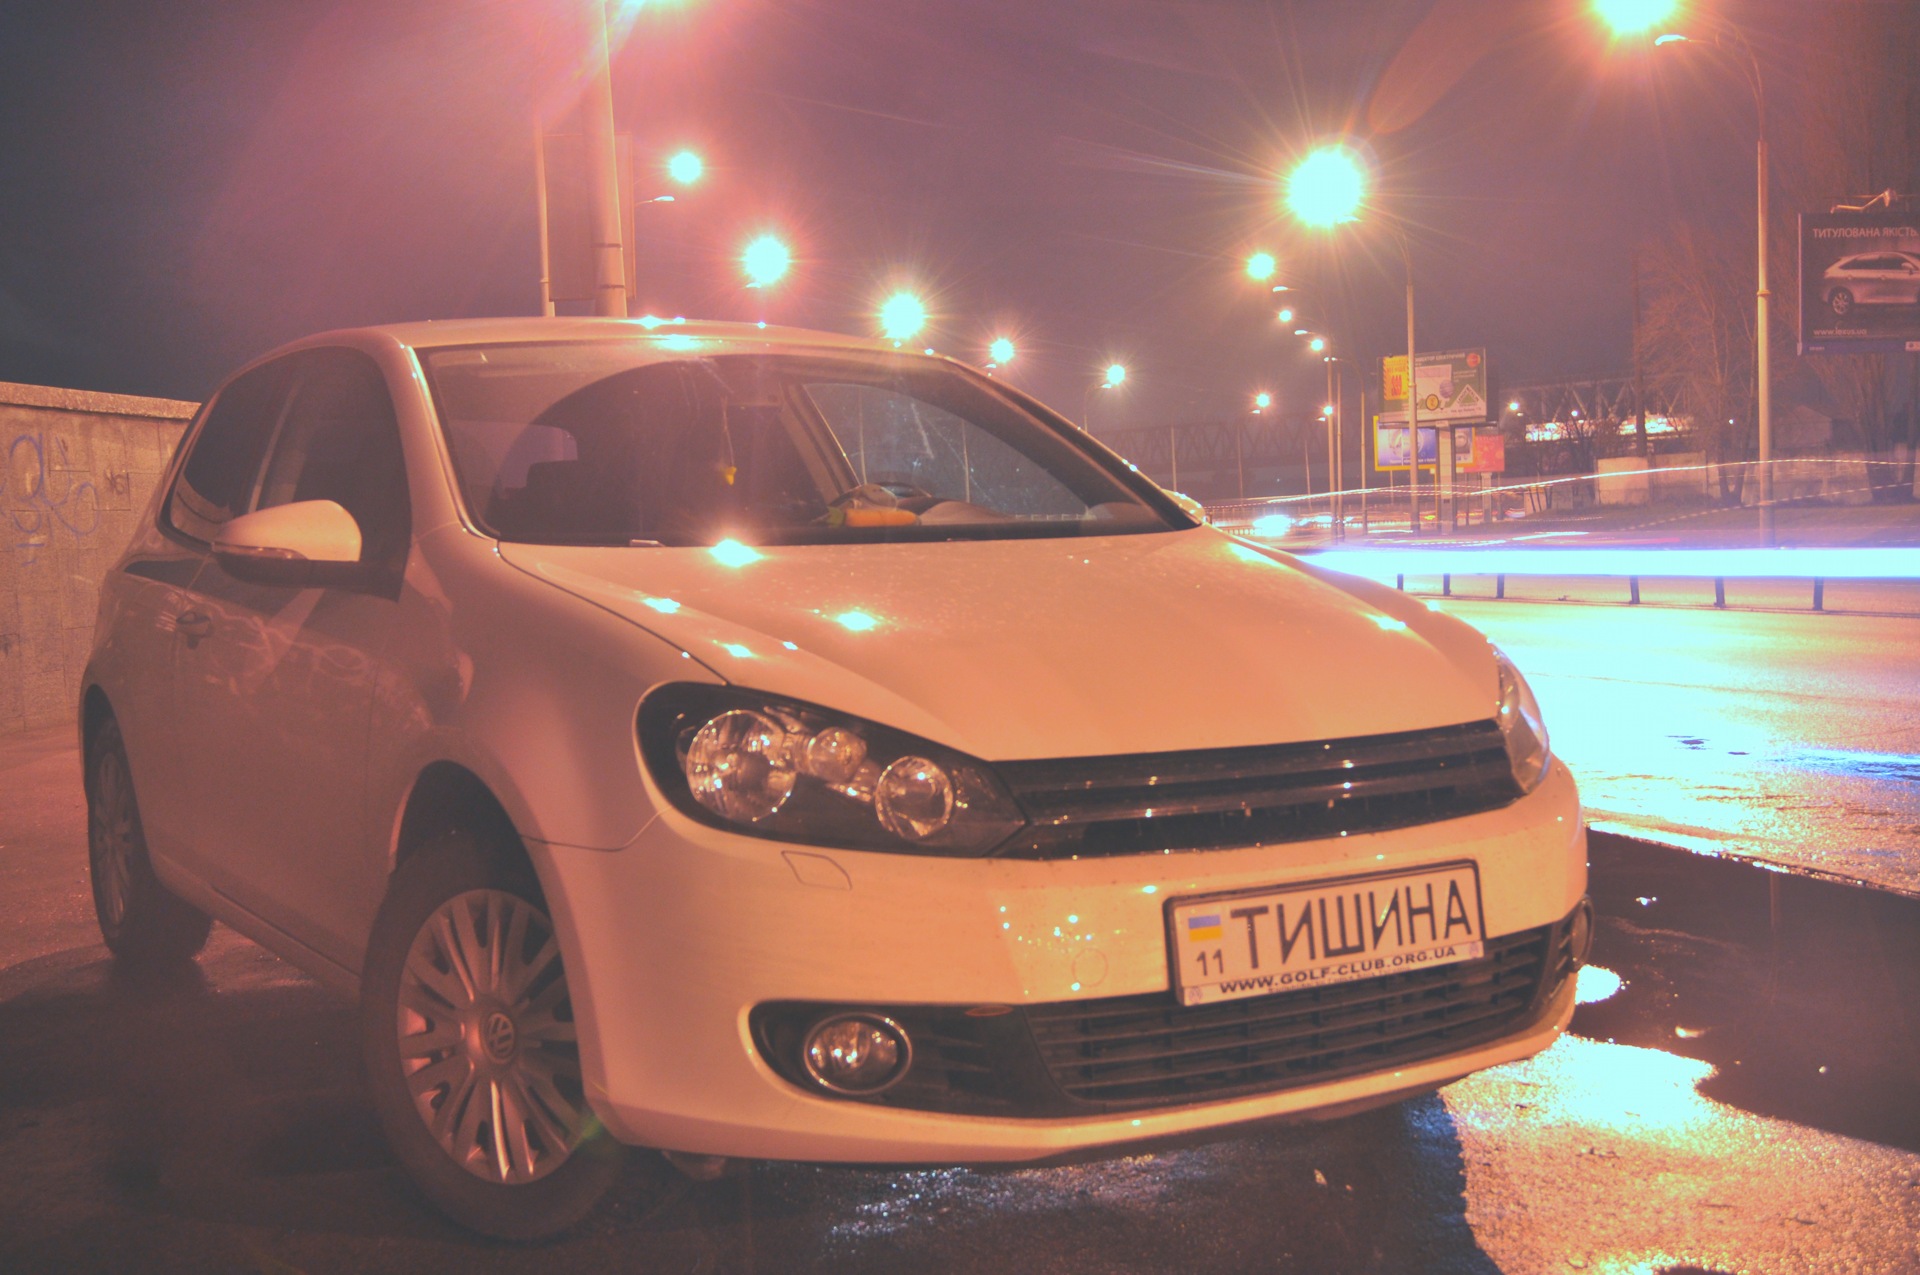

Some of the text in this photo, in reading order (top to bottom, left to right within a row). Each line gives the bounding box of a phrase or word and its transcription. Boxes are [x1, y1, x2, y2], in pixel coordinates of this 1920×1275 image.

[1812, 227, 1881, 239] ТИТУЛОВАНА
[1813, 327, 1868, 337] www.lexus.ua
[1229, 879, 1472, 969] ТИШИНА
[1196, 948, 1224, 977] 11
[1219, 946, 1456, 994] WWW.GOLF-CLUB.ORG.UA
